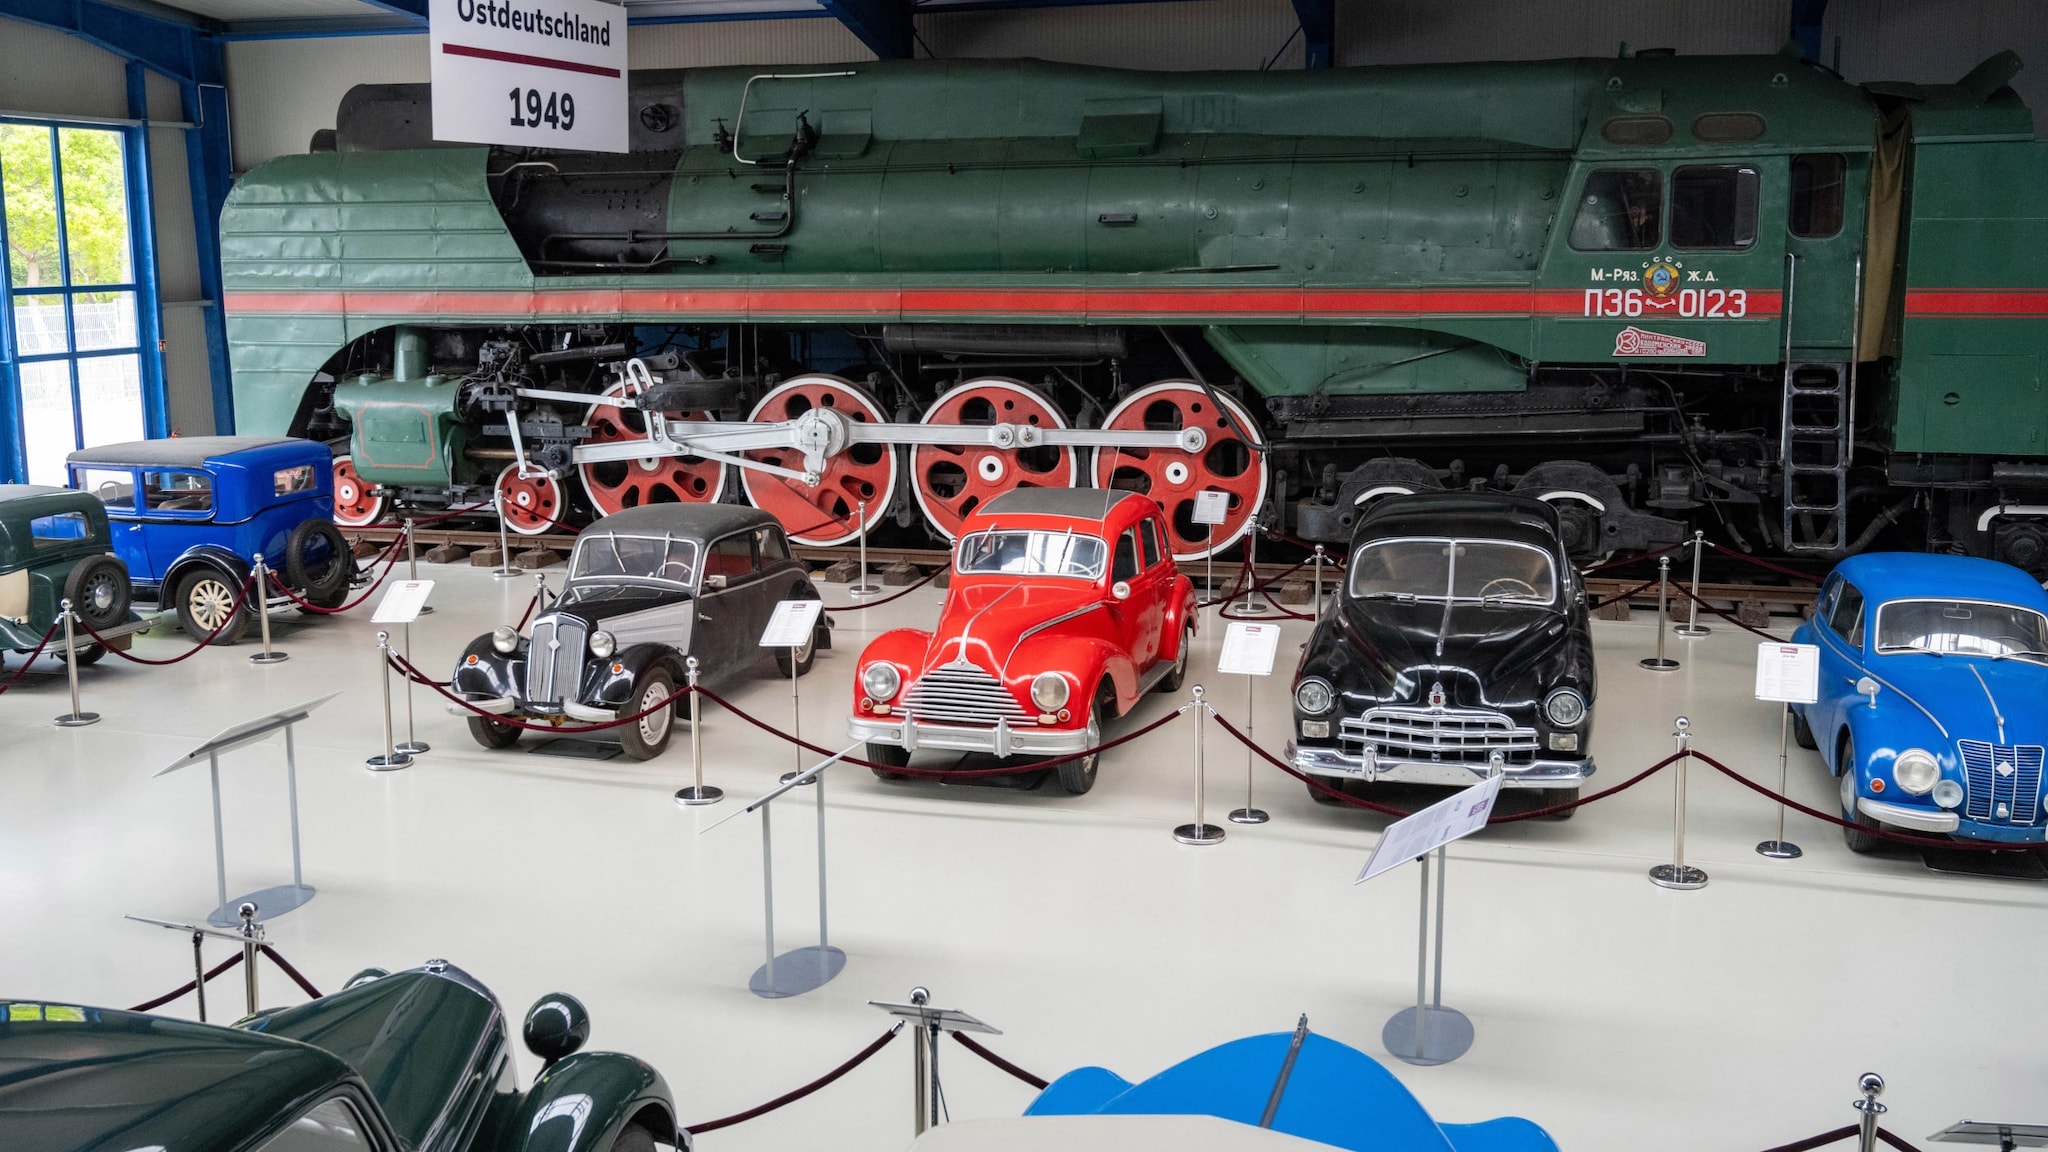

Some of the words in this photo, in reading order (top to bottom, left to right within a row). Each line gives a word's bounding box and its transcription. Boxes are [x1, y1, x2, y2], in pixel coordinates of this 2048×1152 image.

[457, 0, 610, 47] Ostdeutschland
[509, 87, 575, 131] 1949
[1584, 288, 1643, 317] П36
[1678, 288, 1747, 318] 0123
